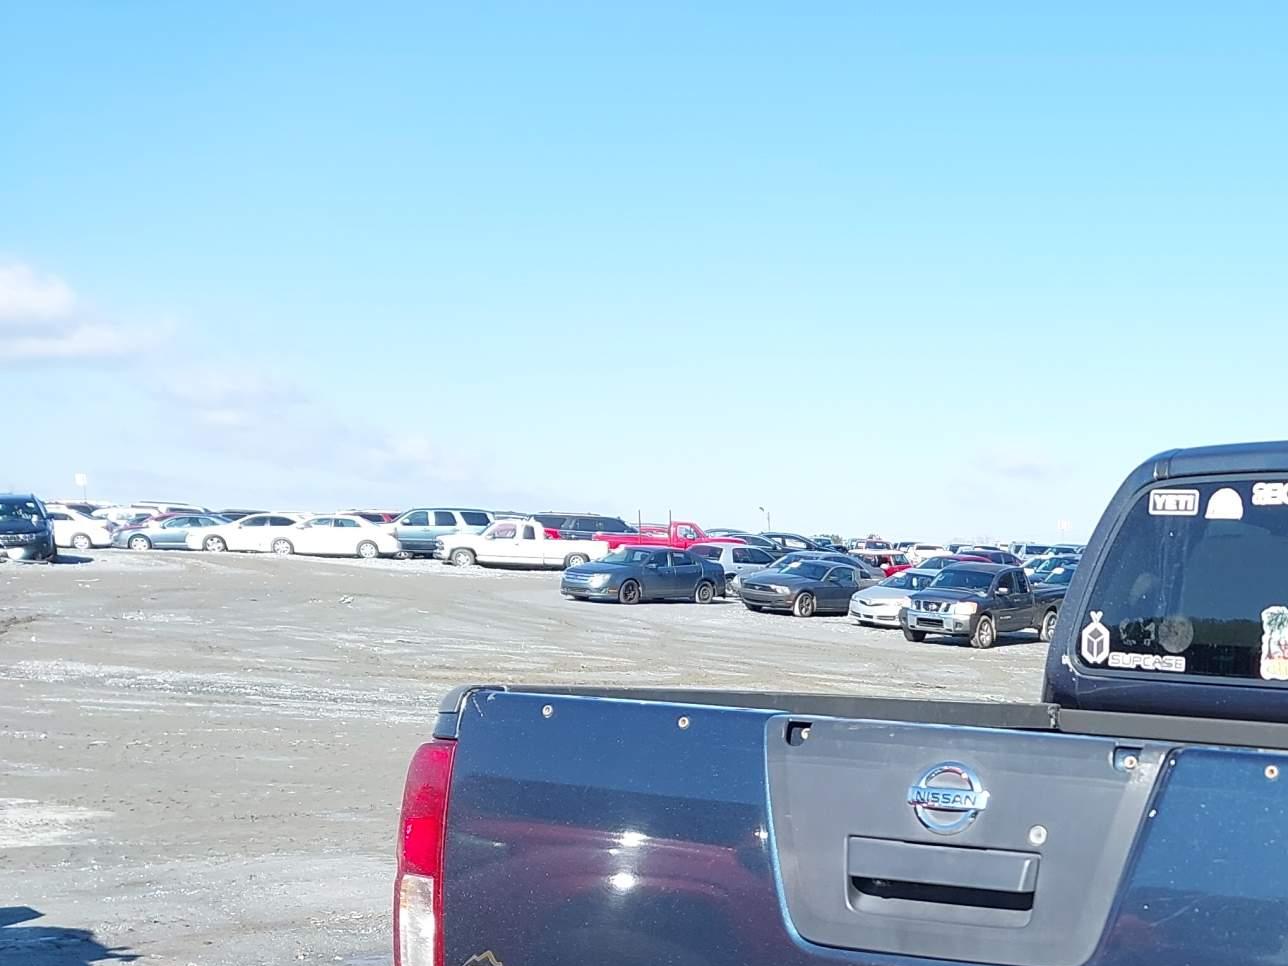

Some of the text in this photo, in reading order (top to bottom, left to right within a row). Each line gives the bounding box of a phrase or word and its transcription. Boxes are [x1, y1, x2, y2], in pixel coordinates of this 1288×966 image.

[1153, 494, 1195, 511] YETI
[1109, 653, 1186, 671] SUPCASE
[915, 790, 977, 806] NISSAN
